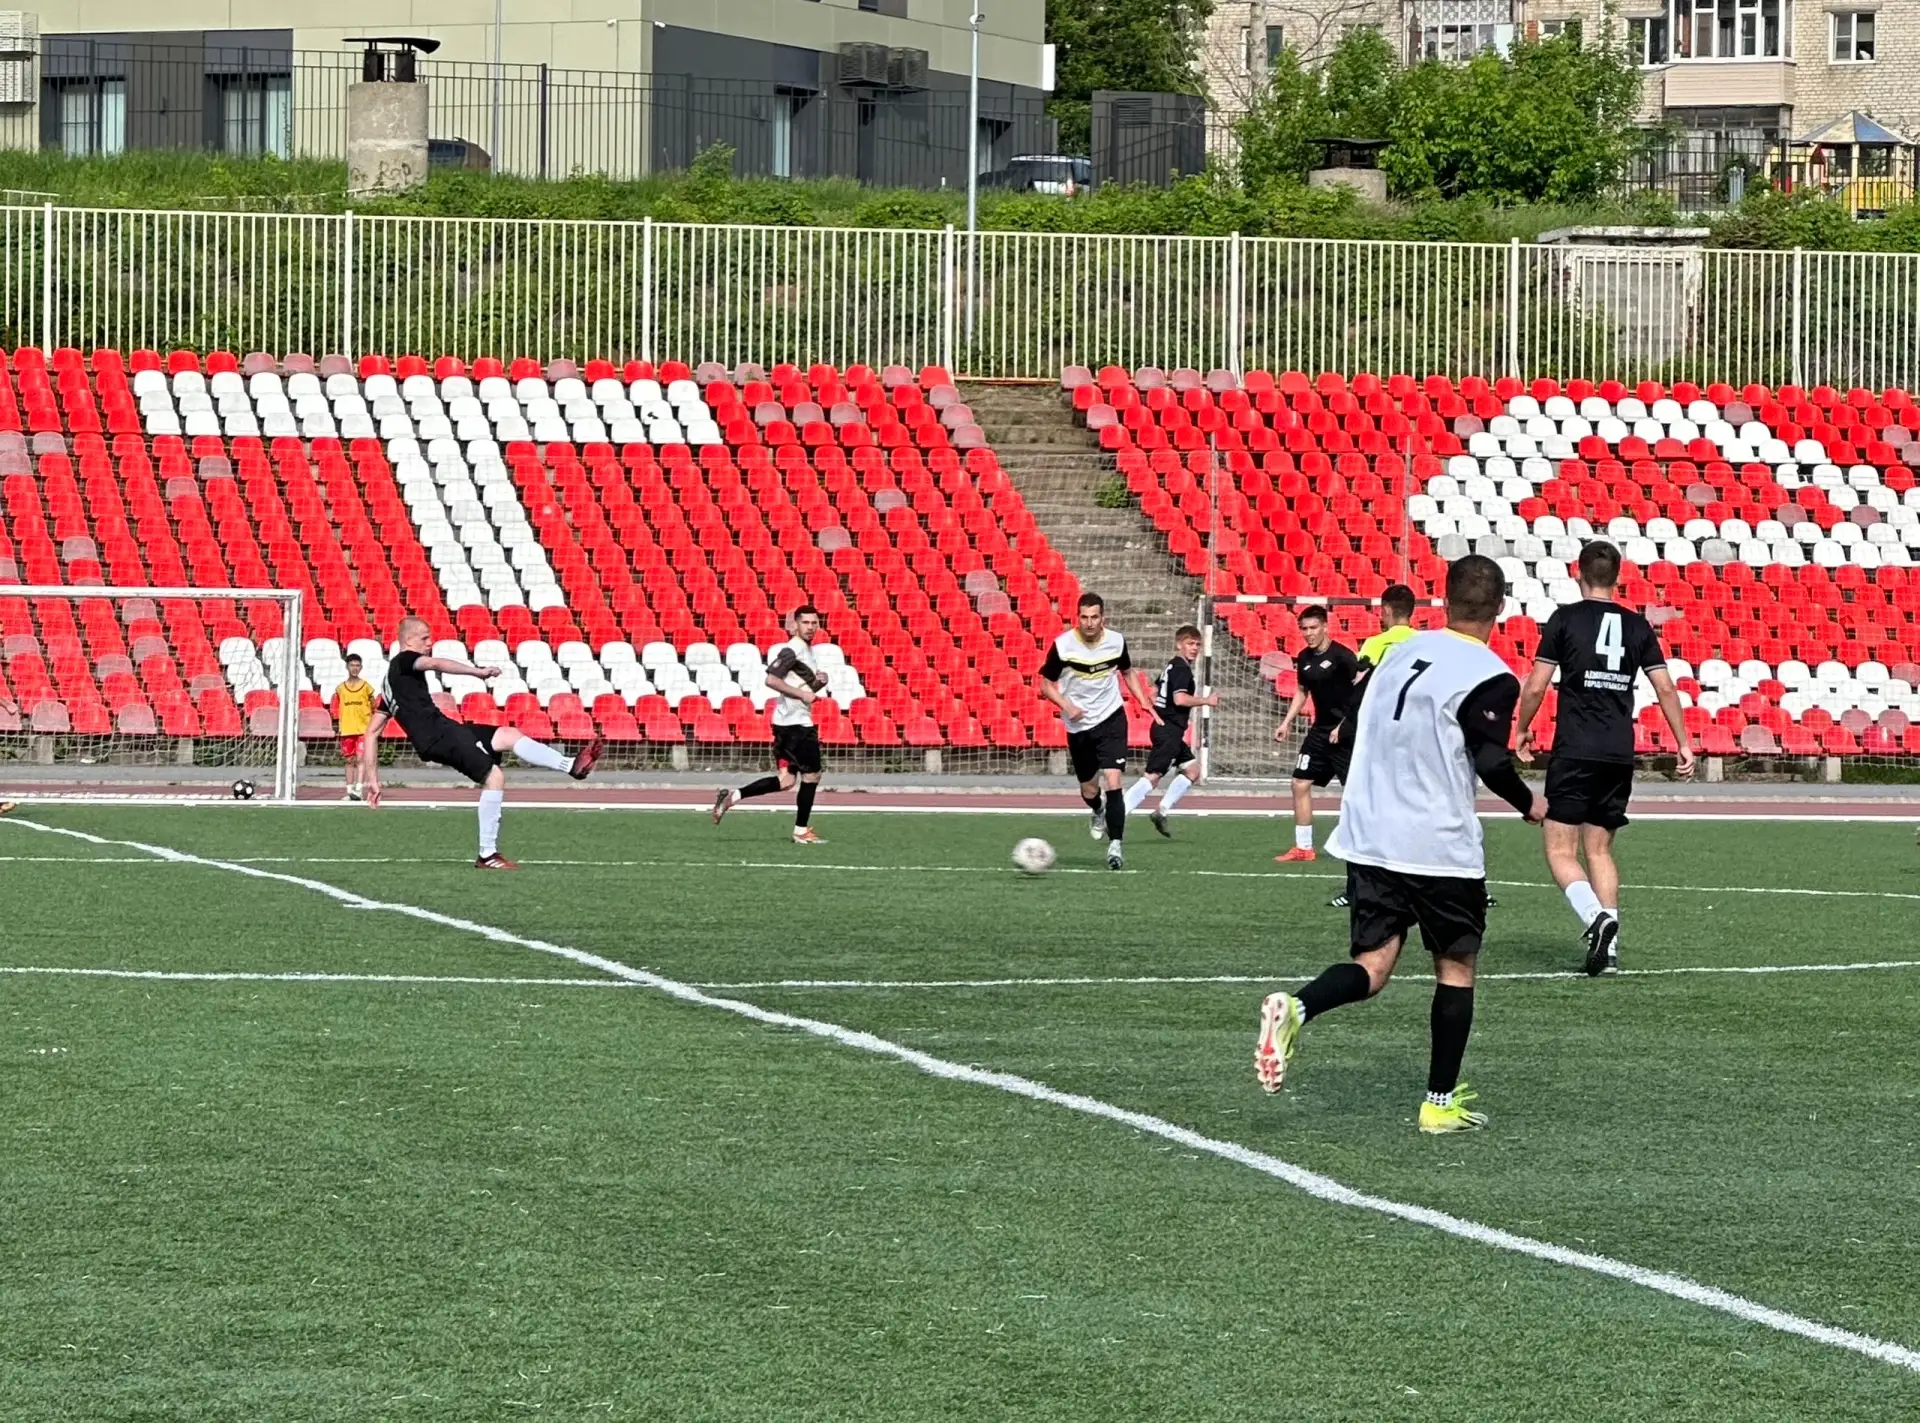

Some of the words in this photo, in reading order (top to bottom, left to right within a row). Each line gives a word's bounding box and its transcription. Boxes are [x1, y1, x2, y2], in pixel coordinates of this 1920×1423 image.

[1596, 612, 1625, 670] 4
[1393, 658, 1433, 721] 7
[1296, 753, 1310, 770] 18
